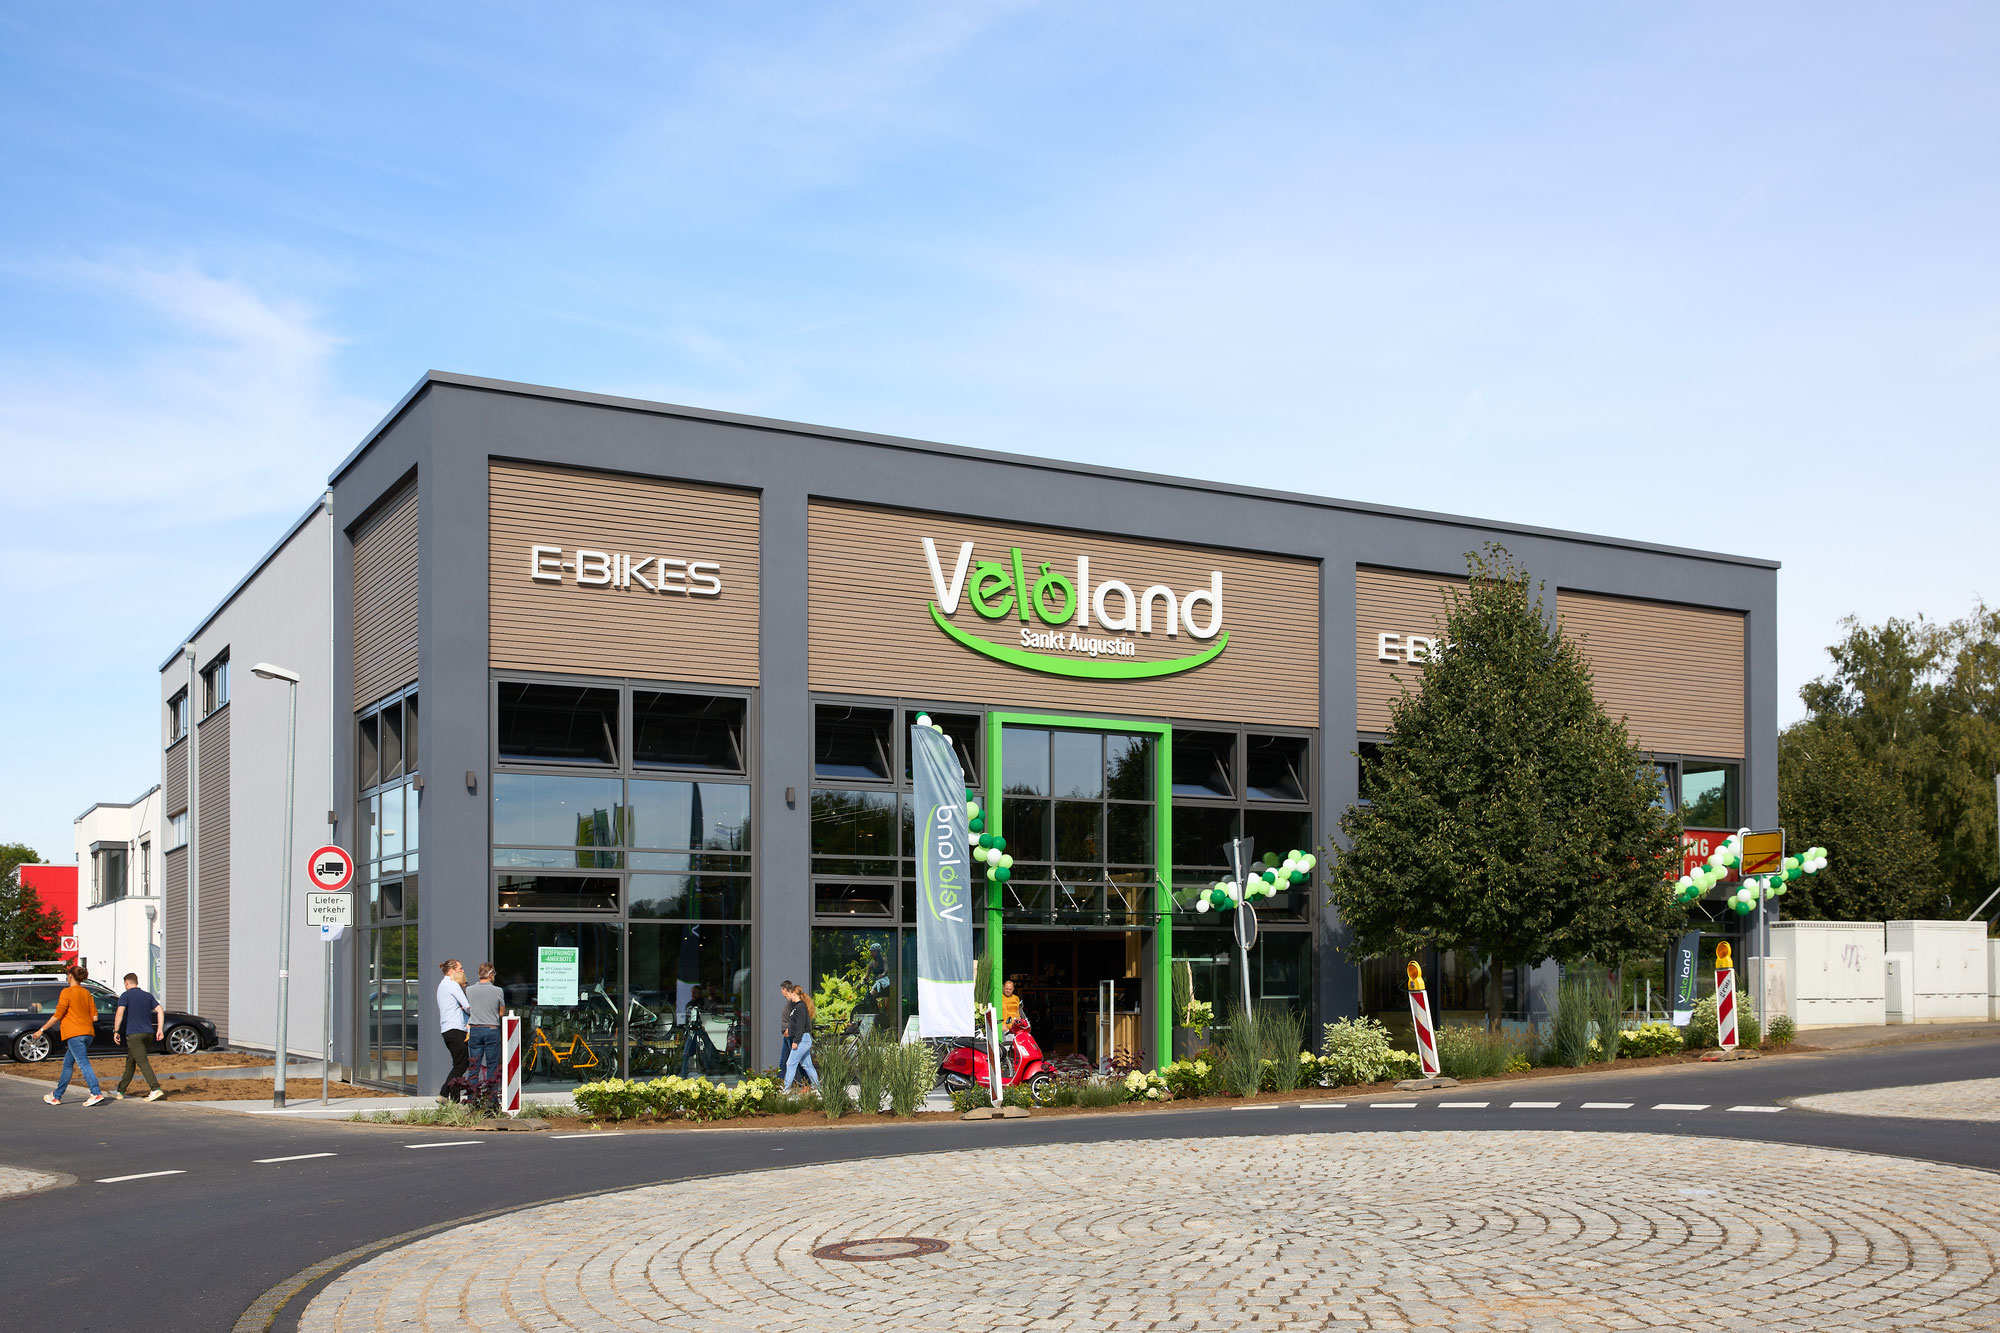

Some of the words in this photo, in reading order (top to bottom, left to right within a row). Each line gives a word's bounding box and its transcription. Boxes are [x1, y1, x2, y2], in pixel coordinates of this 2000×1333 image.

[531, 545, 722, 596] E-BIKES
[921, 537, 1223, 639] Veloland
[1020, 627, 1066, 650] Sankt
[1068, 632, 1135, 658] Augustin
[1678, 950, 1691, 1003] Veloland
